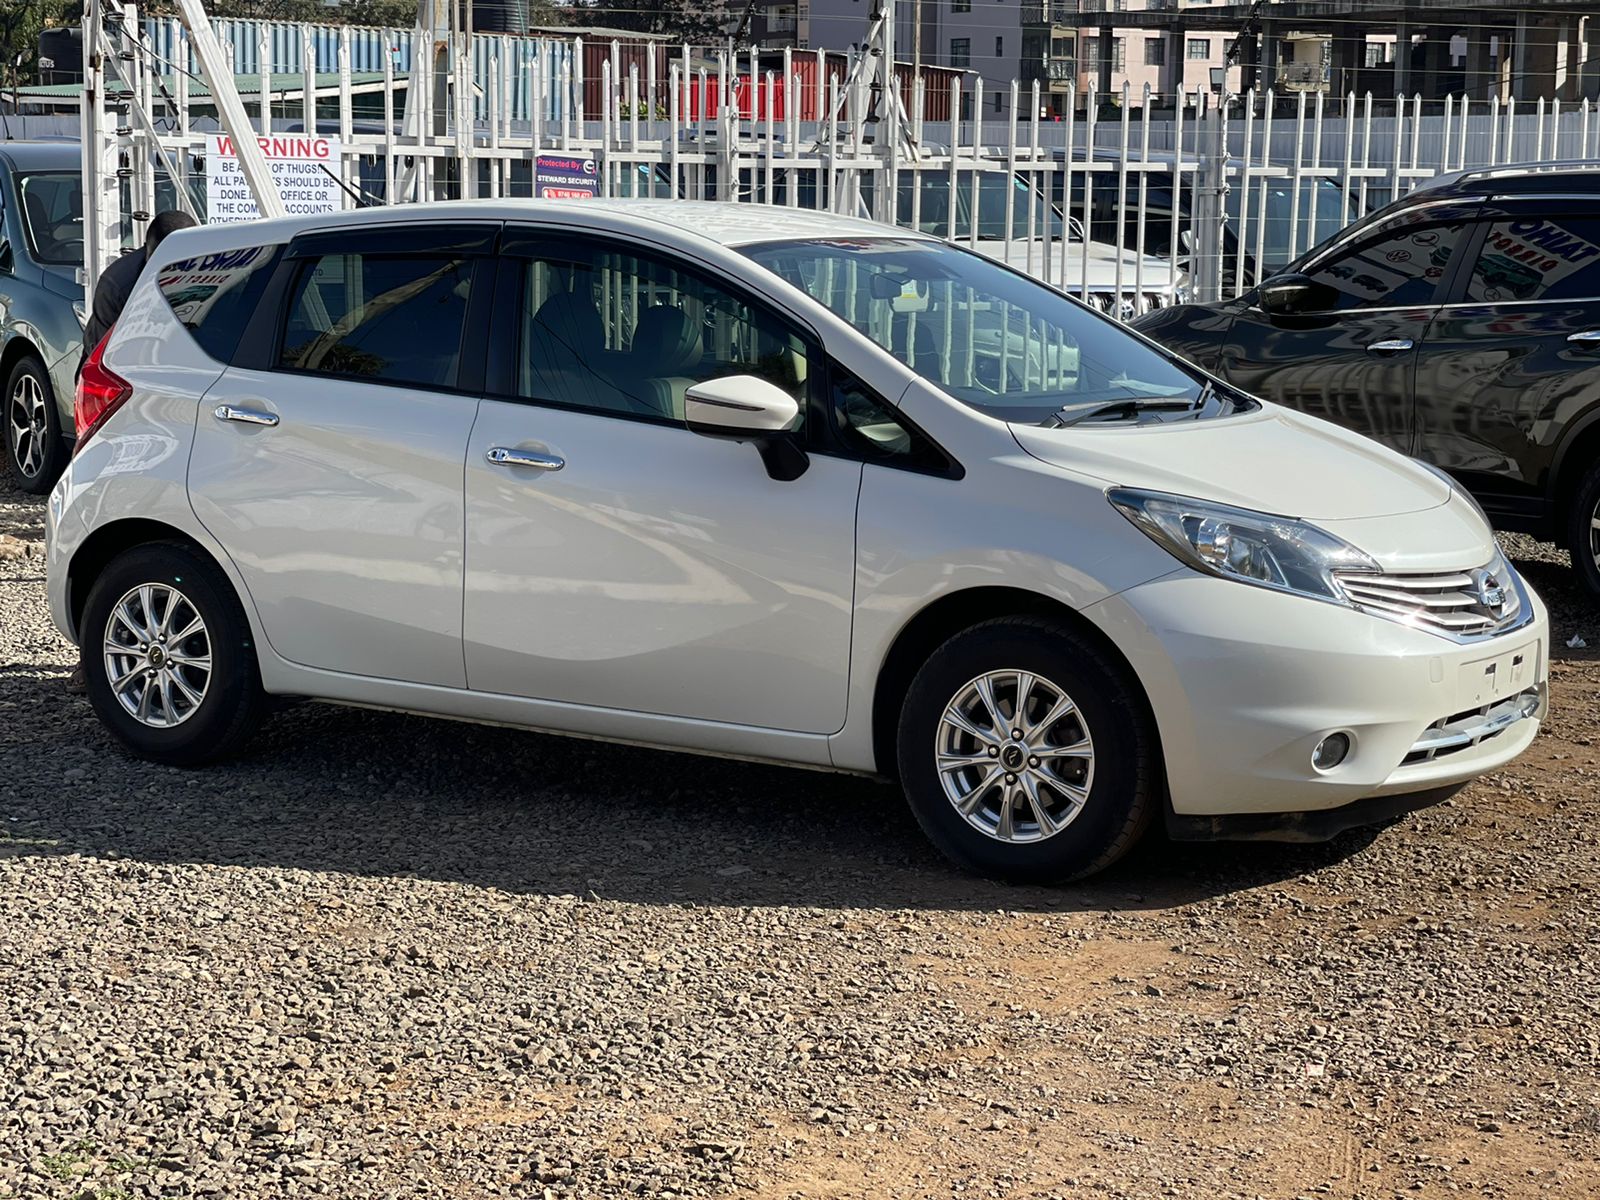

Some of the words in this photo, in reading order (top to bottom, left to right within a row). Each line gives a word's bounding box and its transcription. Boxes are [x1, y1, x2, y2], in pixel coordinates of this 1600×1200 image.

[216, 136, 330, 158] WRNING
[222, 162, 236, 172] BE
[272, 163, 284, 174] OF
[537, 158, 570, 168] Protected
[213, 176, 232, 186] ALL
[284, 178, 320, 187] SHOULD
[322, 178, 335, 188] BE
[537, 174, 567, 184] STEWARD
[568, 177, 597, 186] SECURITY
[220, 190, 246, 200] DONE
[280, 190, 312, 200] OFFICE
[314, 191, 328, 200] OR
[216, 203, 235, 213] THE
[285, 204, 333, 214] ACCOUNTS
